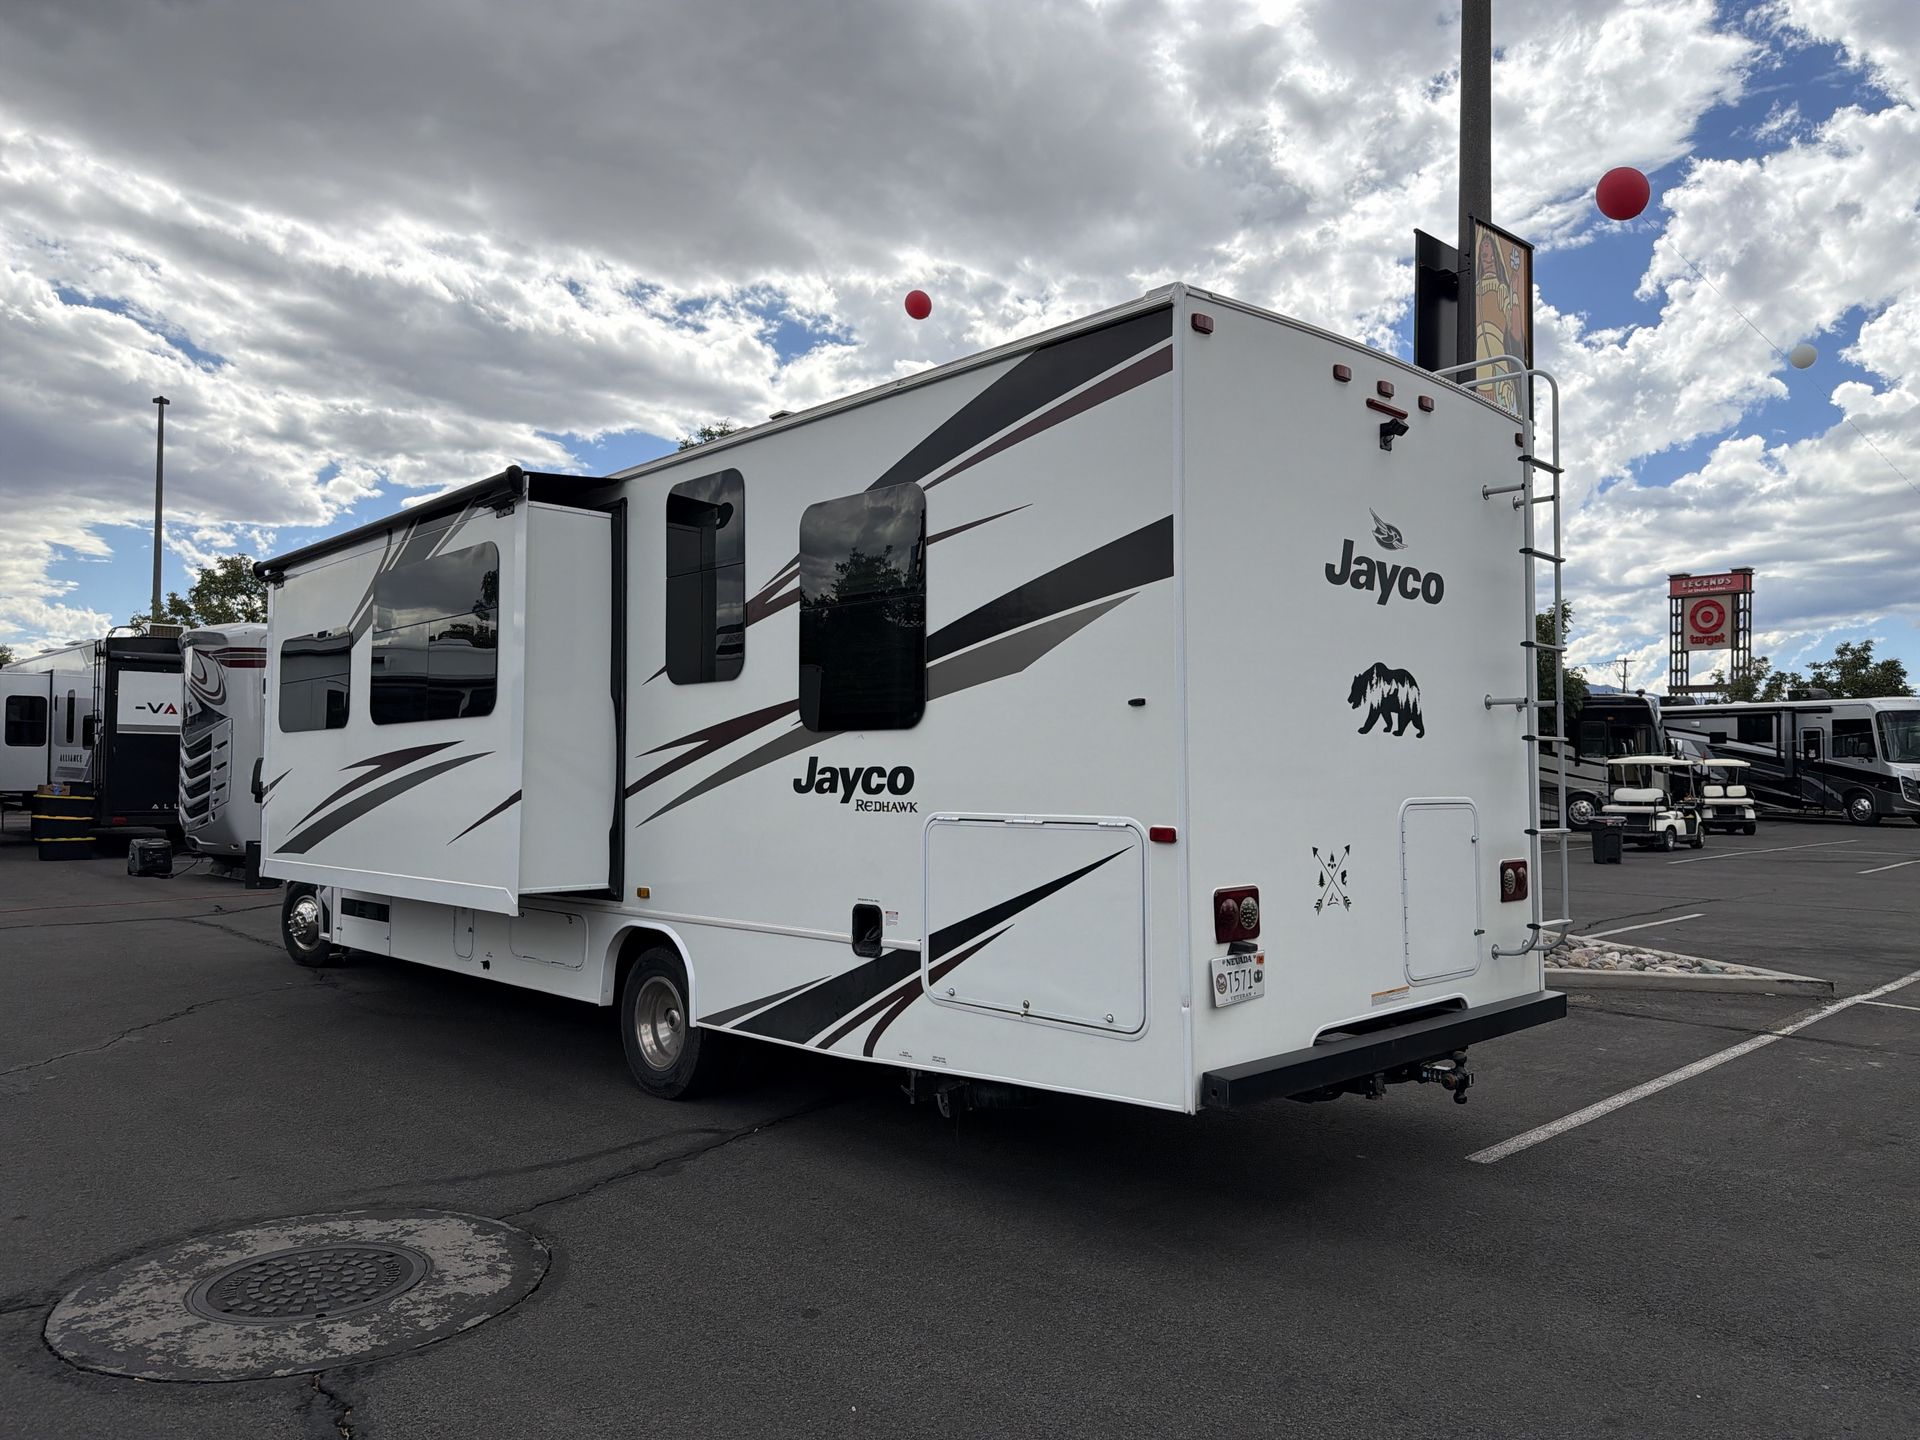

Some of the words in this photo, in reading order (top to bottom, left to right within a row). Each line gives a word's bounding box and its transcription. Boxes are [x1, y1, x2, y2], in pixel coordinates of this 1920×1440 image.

[1325, 538, 1444, 606] Jayco
[1682, 577, 1732, 588] LEGENDS
[1689, 633, 1725, 645] target
[793, 756, 914, 804] Jayco
[855, 799, 918, 814] REDHAWK
[1226, 955, 1252, 966] NEVADA
[1231, 992, 1252, 1001] VETERAN
